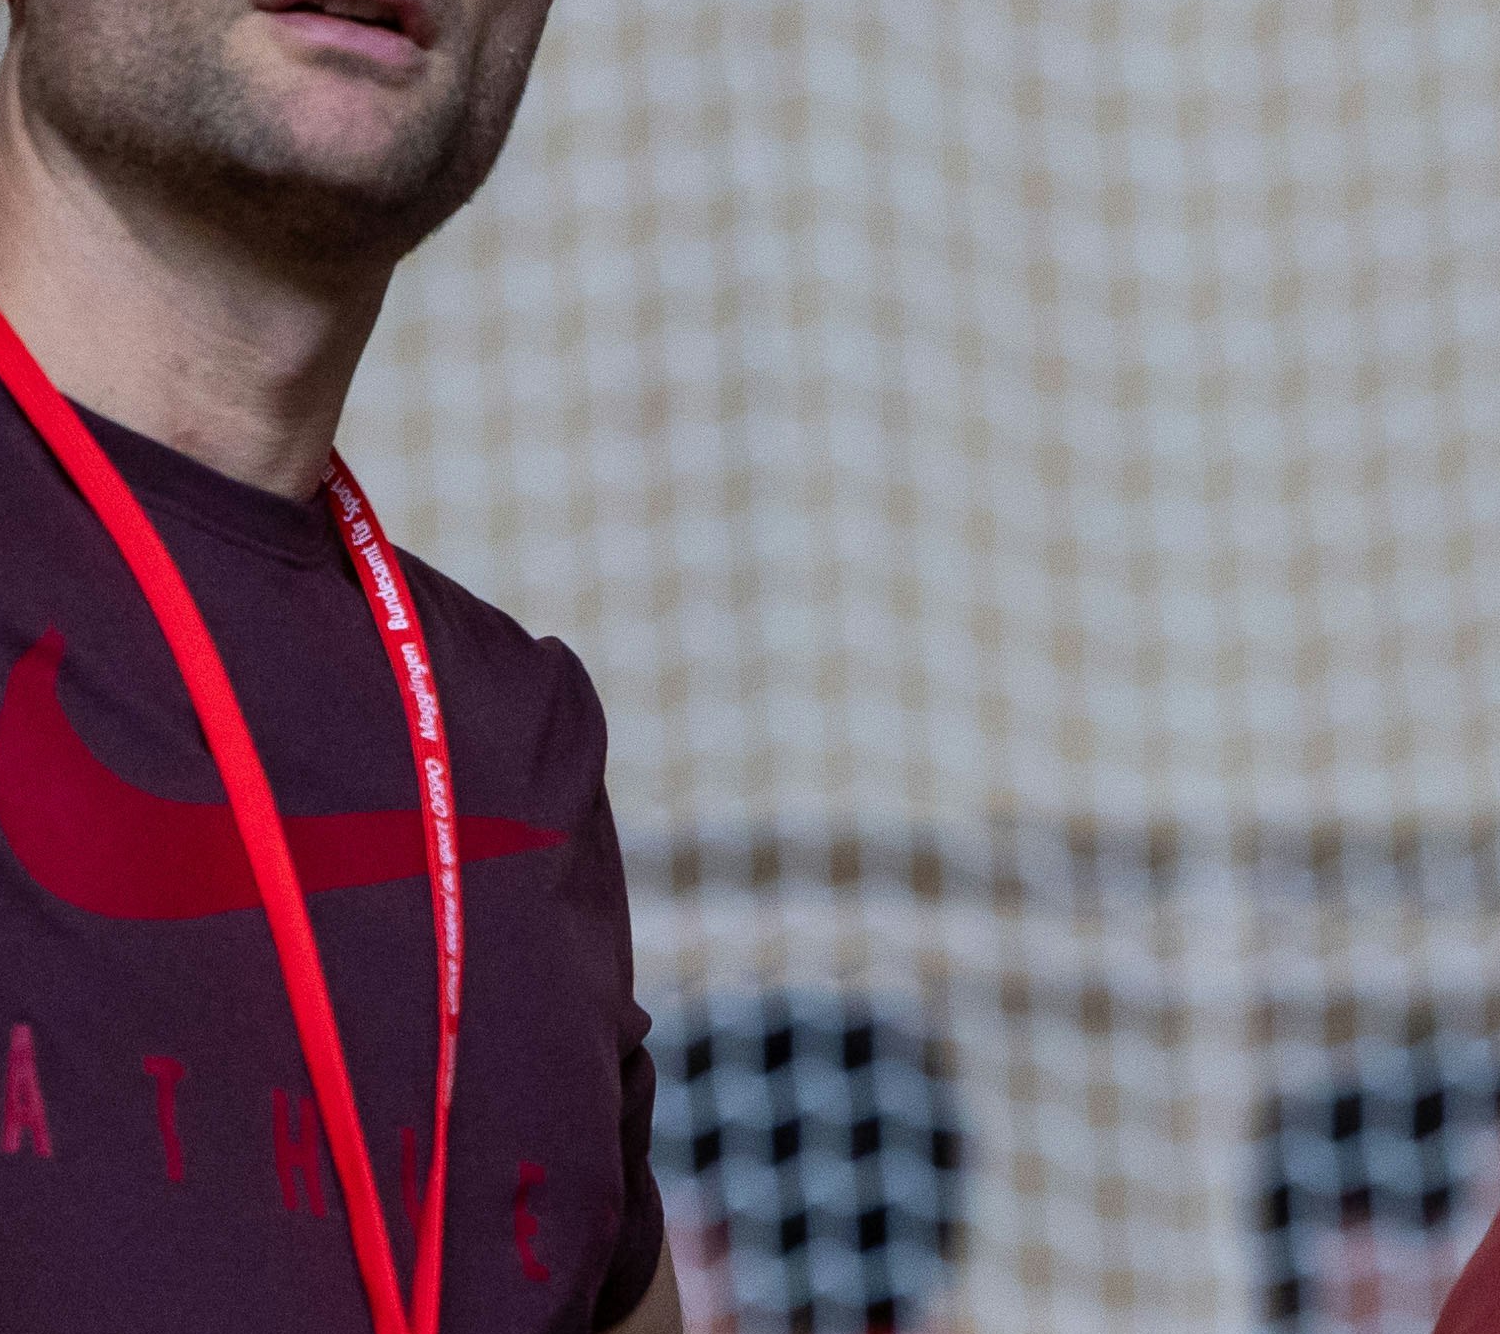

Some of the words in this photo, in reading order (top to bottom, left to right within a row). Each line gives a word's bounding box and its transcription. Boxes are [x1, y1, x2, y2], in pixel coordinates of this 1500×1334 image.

[329, 476, 363, 523] Sport
[351, 517, 373, 547] für
[360, 539, 410, 631] Bundesamt
[401, 641, 439, 742] Magglingen
